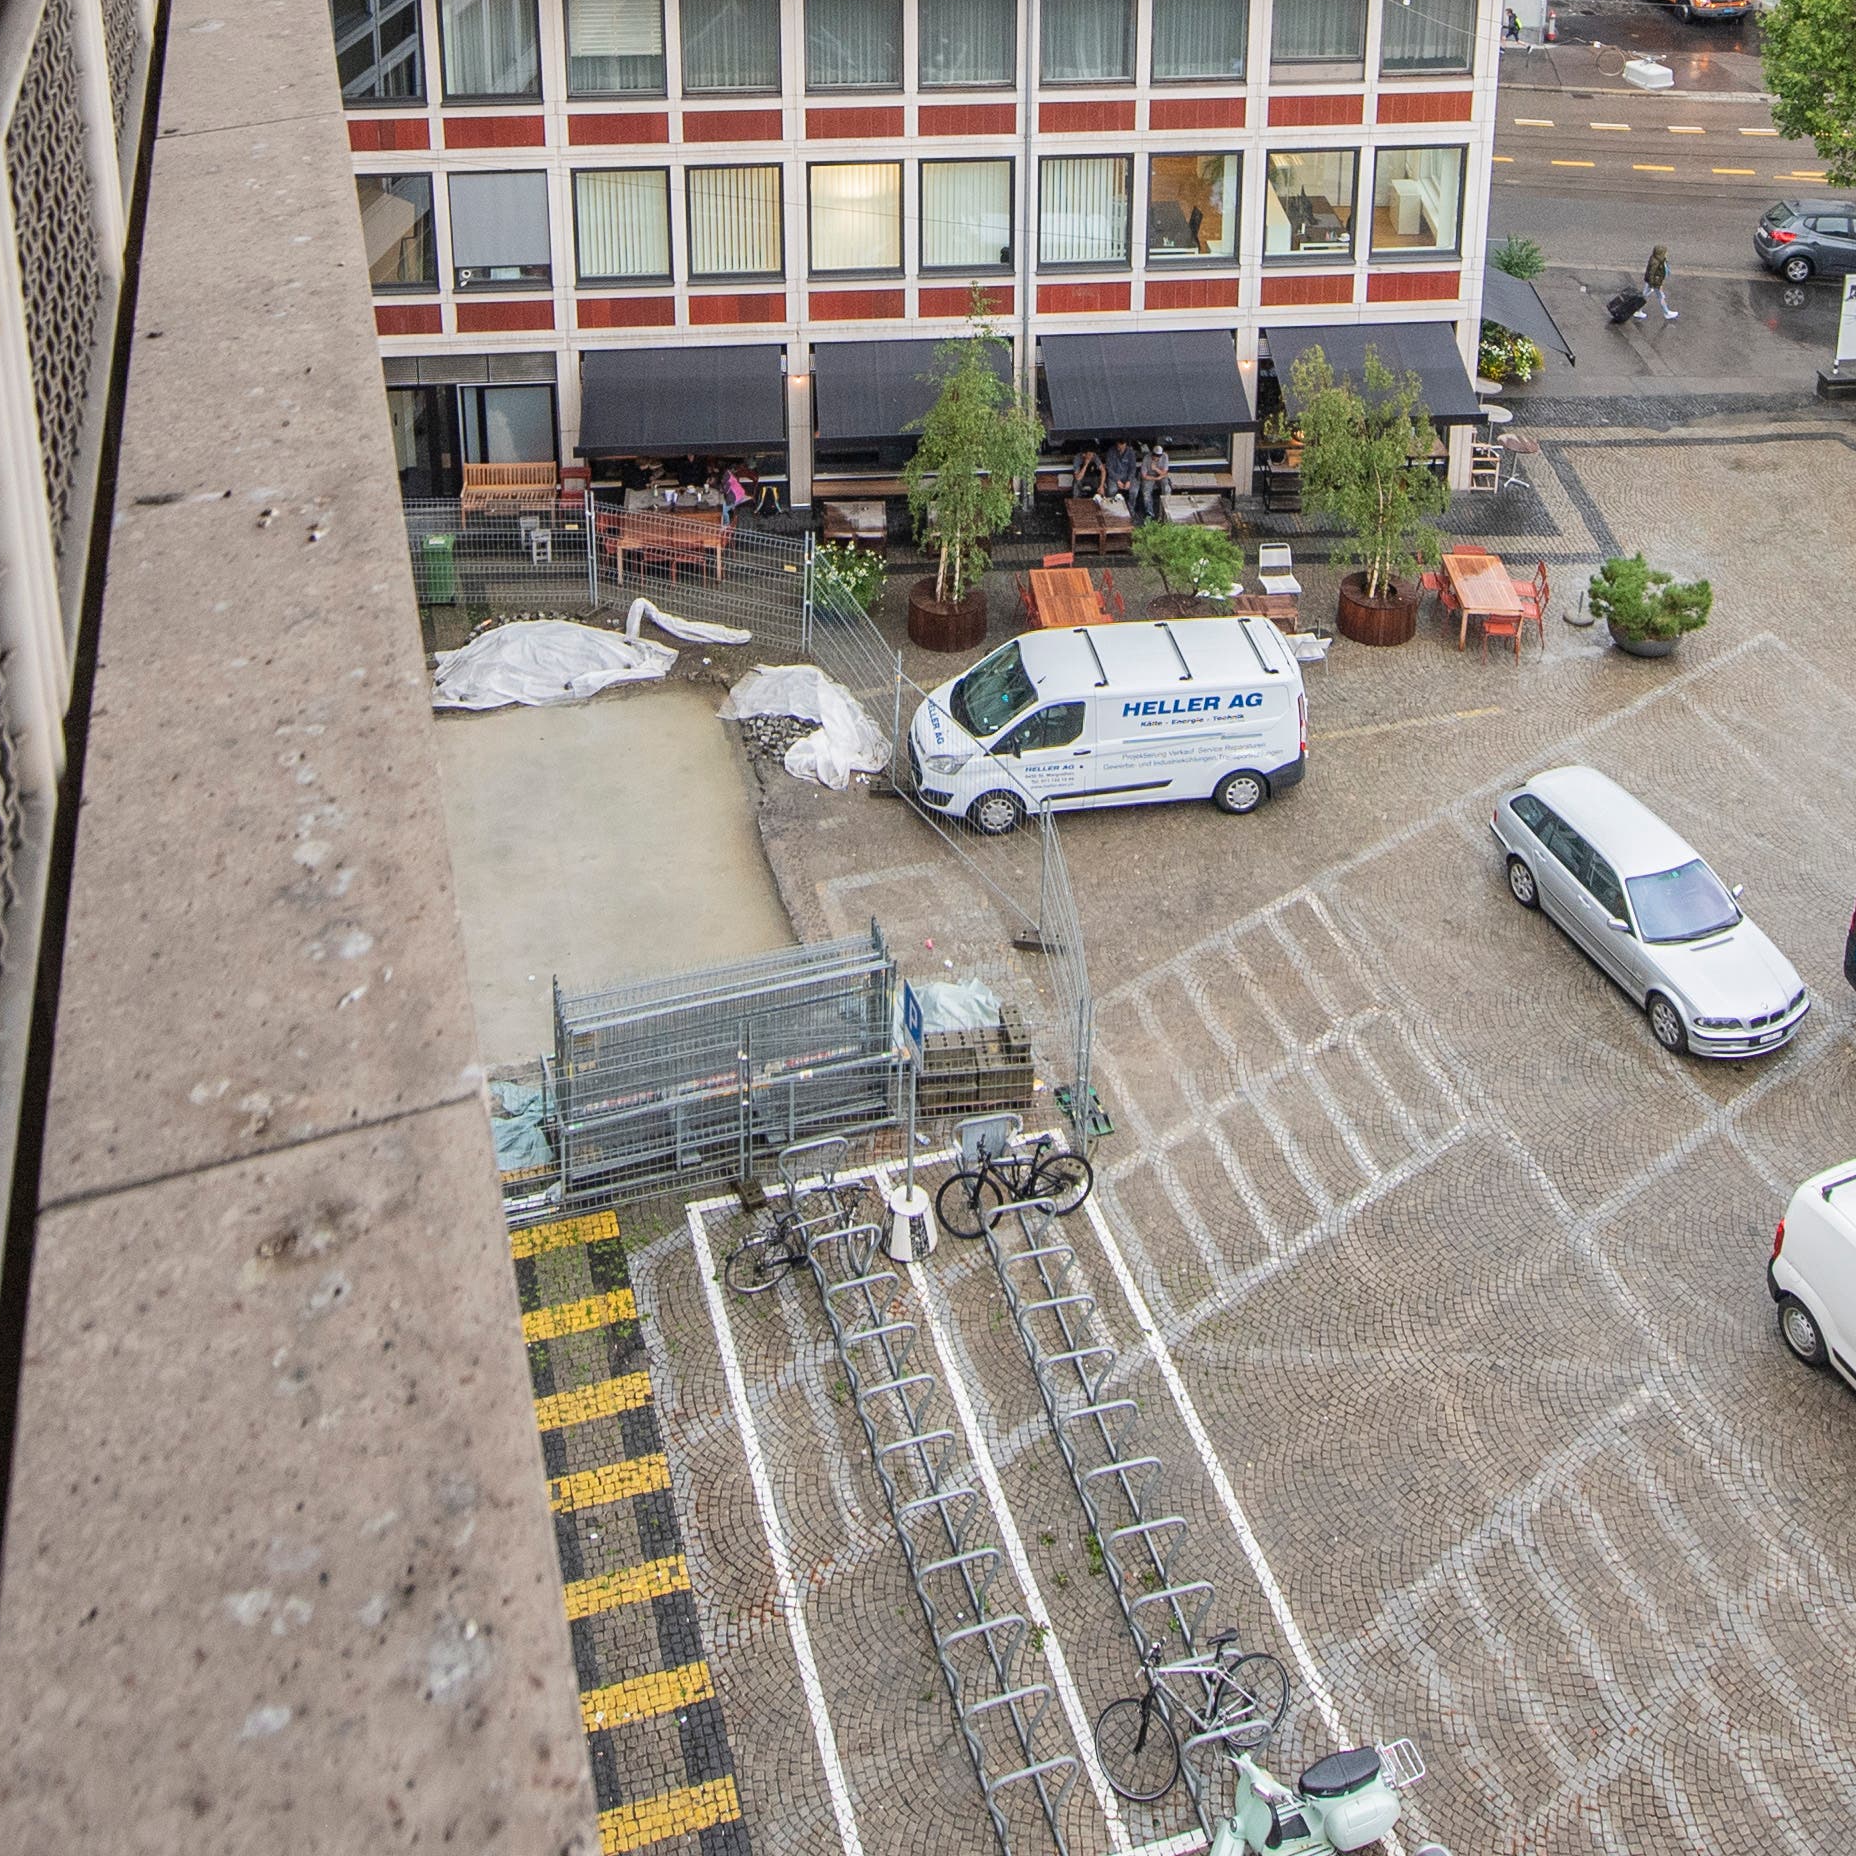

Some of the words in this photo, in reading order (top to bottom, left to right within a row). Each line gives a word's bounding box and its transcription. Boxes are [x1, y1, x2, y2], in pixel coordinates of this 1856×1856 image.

[1122, 696, 1221, 717] HELLER
[1228, 692, 1264, 709] AG
[1025, 765, 1060, 773] HELLER
[909, 996, 918, 1031] P
